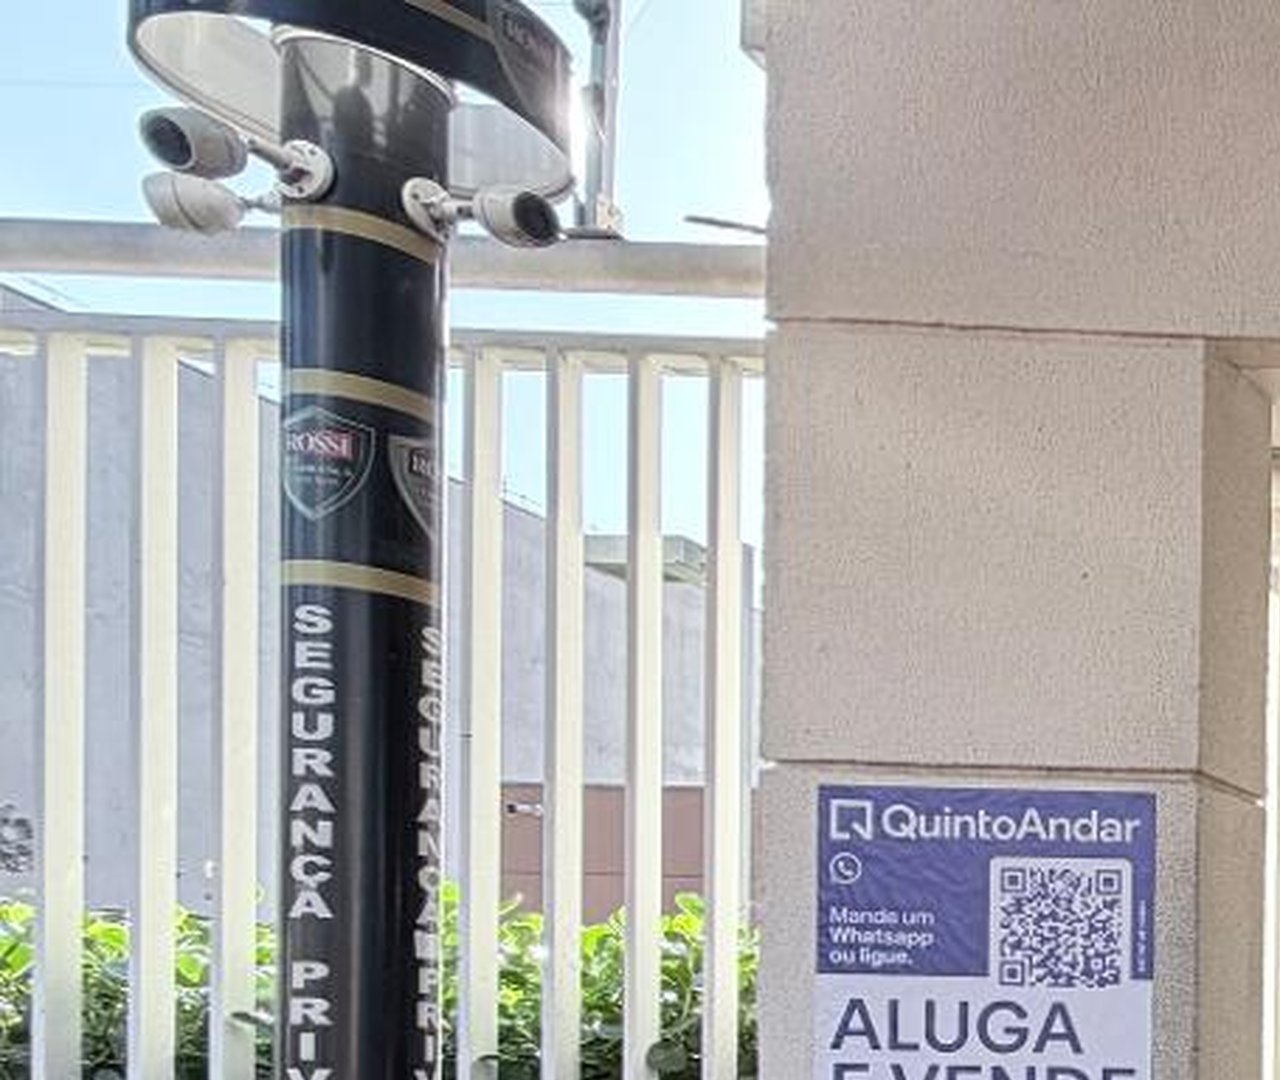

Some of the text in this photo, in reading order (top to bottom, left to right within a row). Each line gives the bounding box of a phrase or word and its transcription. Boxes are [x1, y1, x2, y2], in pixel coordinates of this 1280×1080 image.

[285, 431, 350, 457] ROSSI
[289, 604, 335, 919] SEGURANÇA
[881, 803, 1141, 843] QuintoAndar
[829, 906, 935, 925] Manda um
[828, 926, 935, 949] Whatsapp
[829, 946, 913, 967] ou ligue.
[830, 998, 1084, 1054] ALUGA
